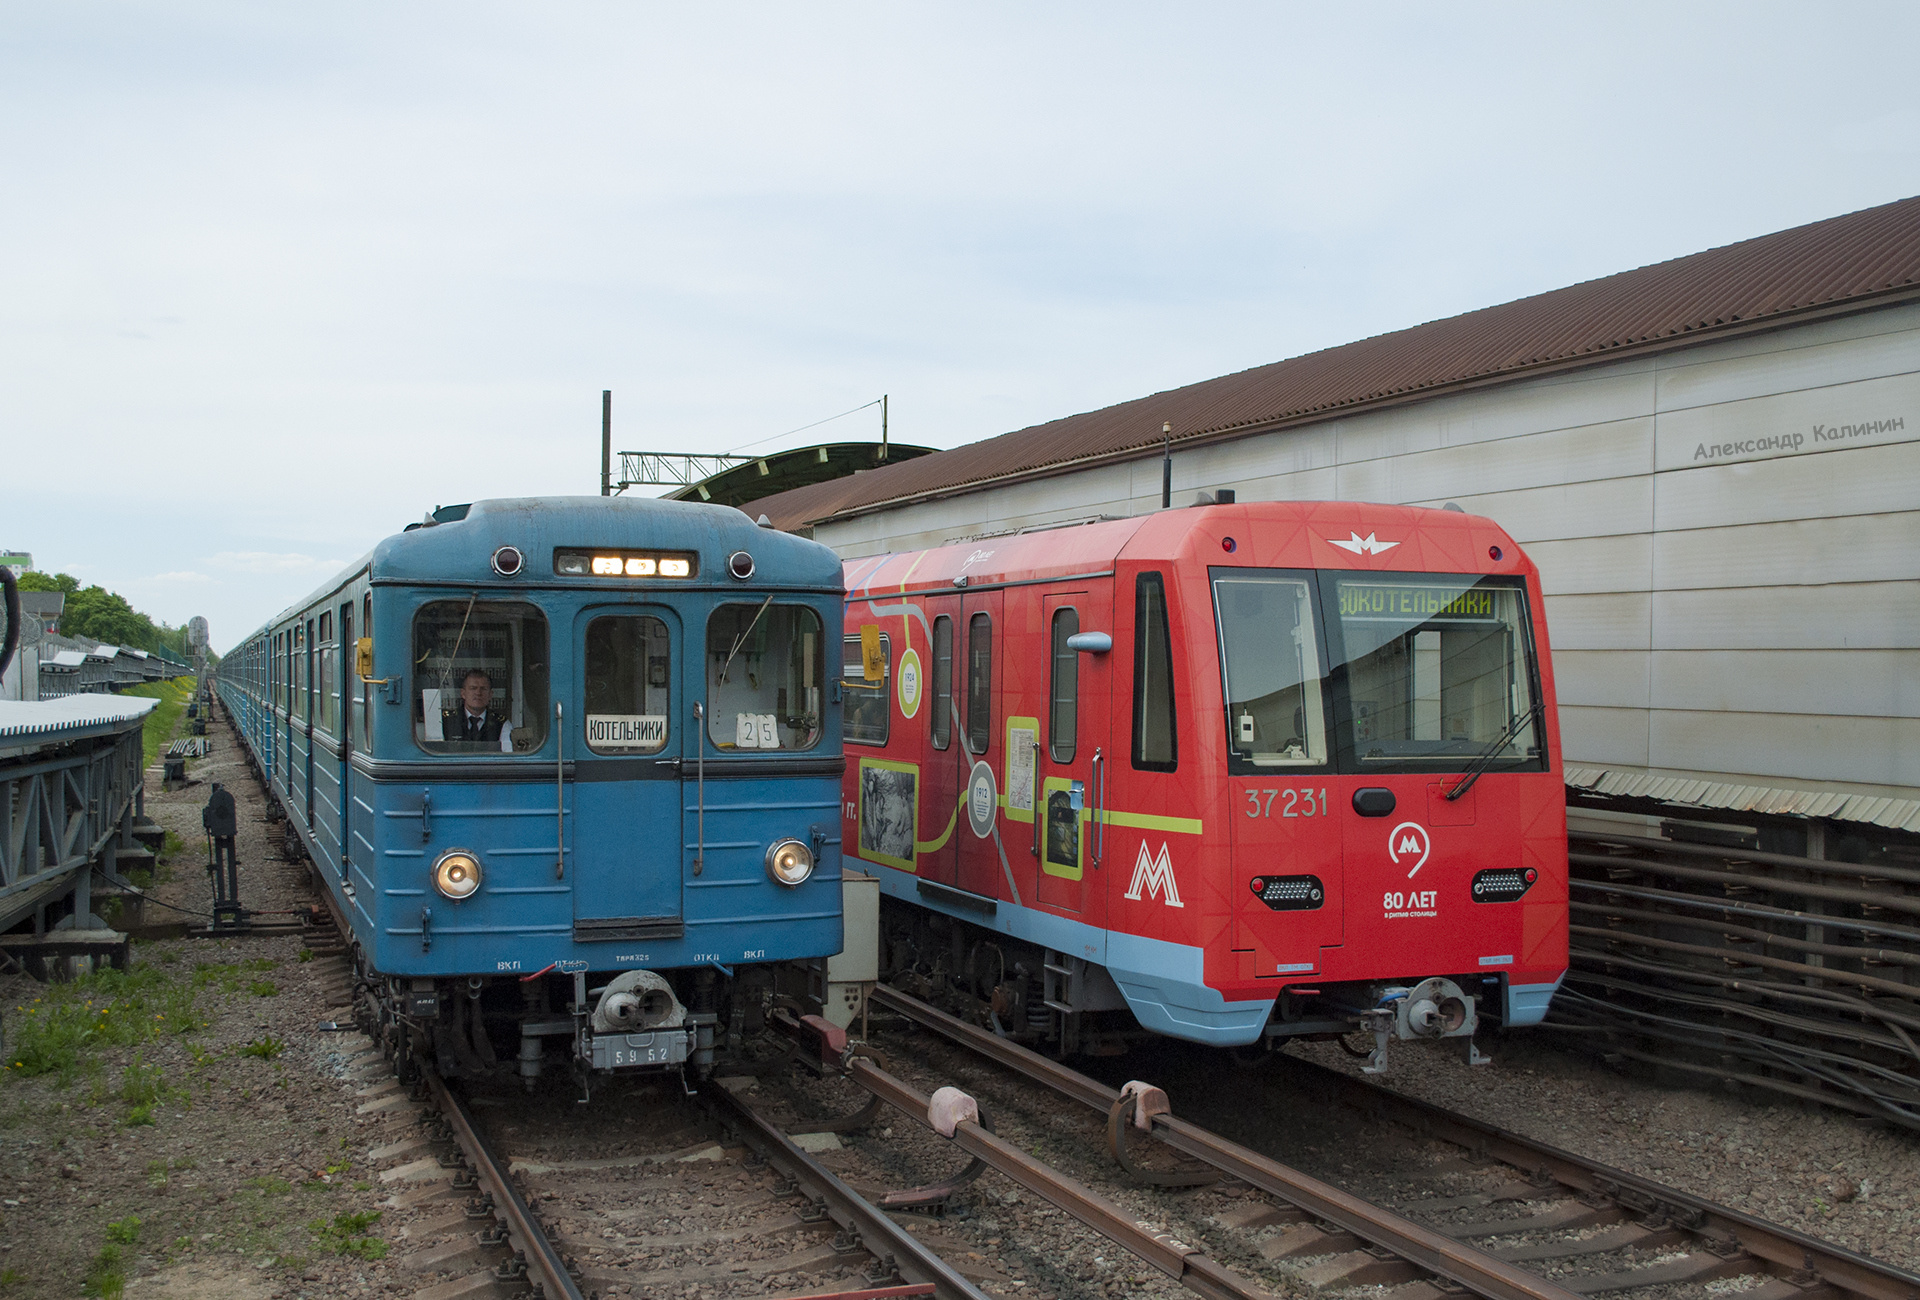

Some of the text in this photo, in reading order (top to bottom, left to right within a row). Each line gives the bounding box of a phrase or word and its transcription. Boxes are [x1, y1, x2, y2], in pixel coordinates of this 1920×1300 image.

[1358, 588, 1491, 614] КОТЕЛЬНИКИ
[1245, 788, 1327, 818] 37231
[1383, 891, 1437, 910] 80 ЛЕТ
[743, 950, 765, 959] ВКЛ
[497, 961, 520, 970] ВКЛ
[615, 1047, 668, 1064] 5952
